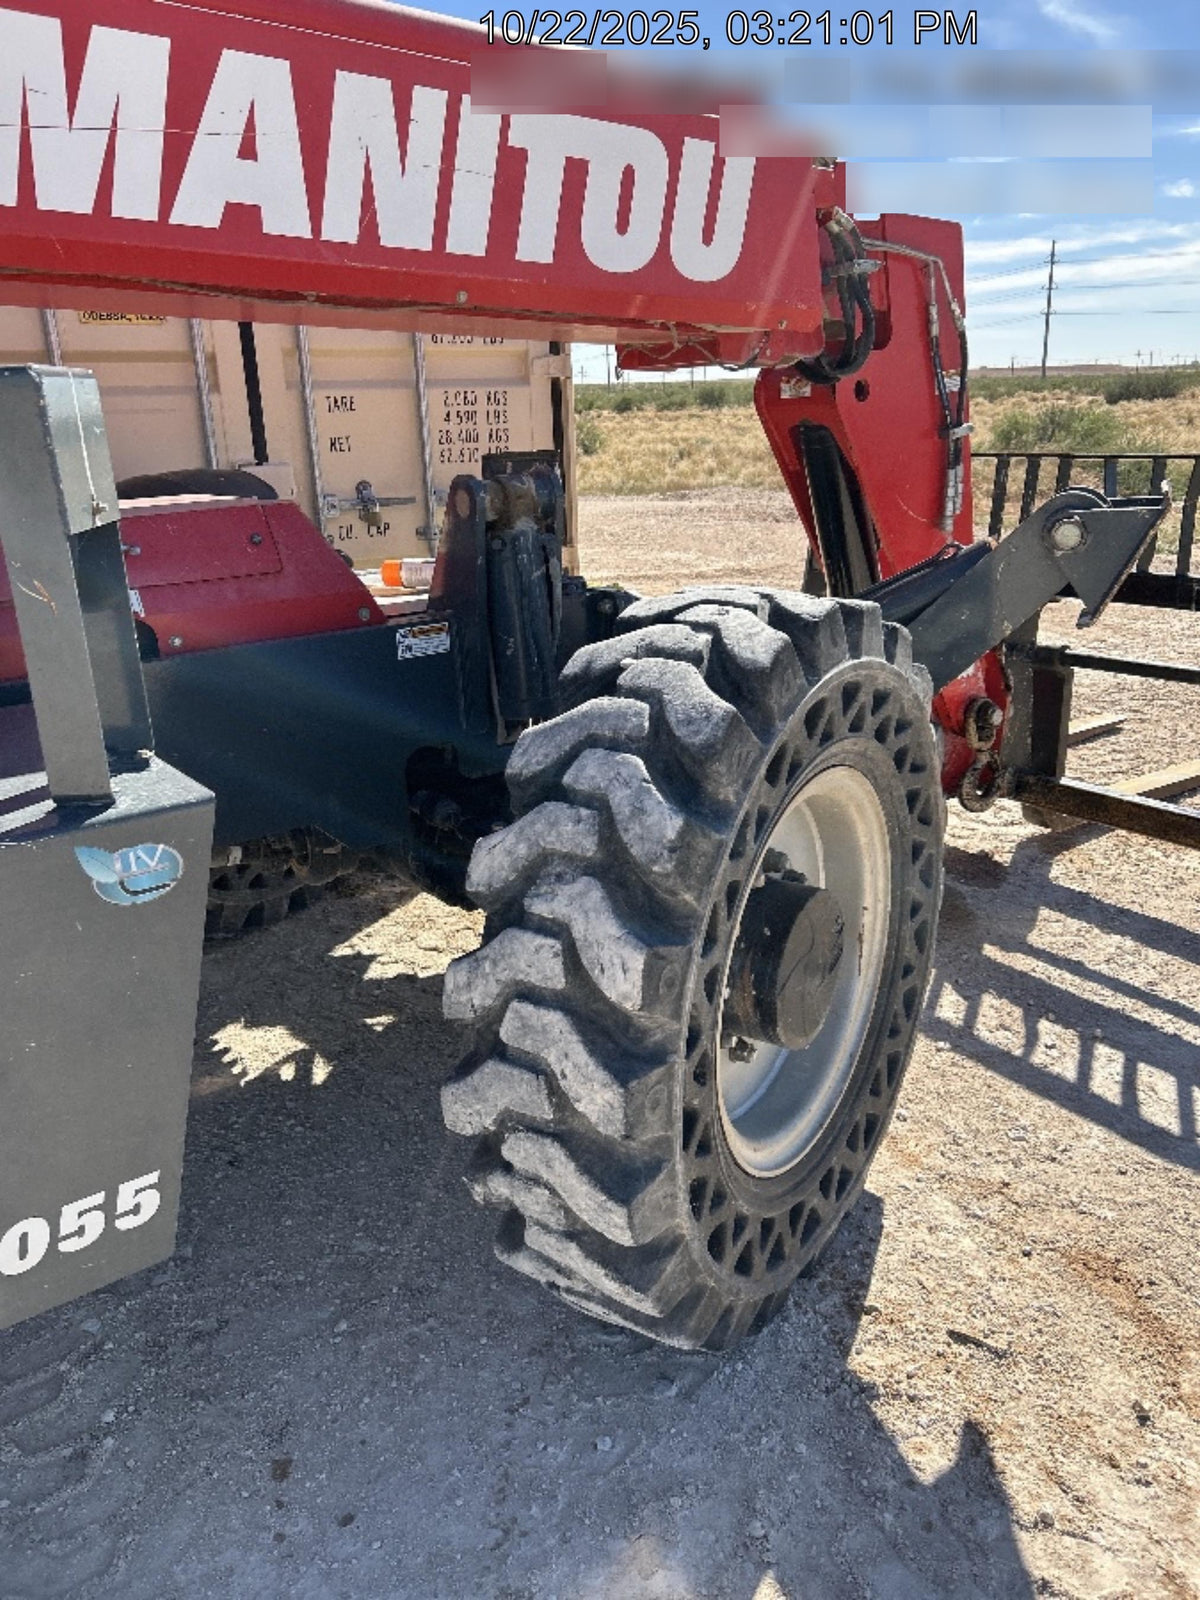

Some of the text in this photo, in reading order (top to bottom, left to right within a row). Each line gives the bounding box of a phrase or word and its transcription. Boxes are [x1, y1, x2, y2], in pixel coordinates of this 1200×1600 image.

[0, 9, 757, 282] MANITOU
[325, 396, 356, 413] TARE
[329, 435, 351, 452] NET
